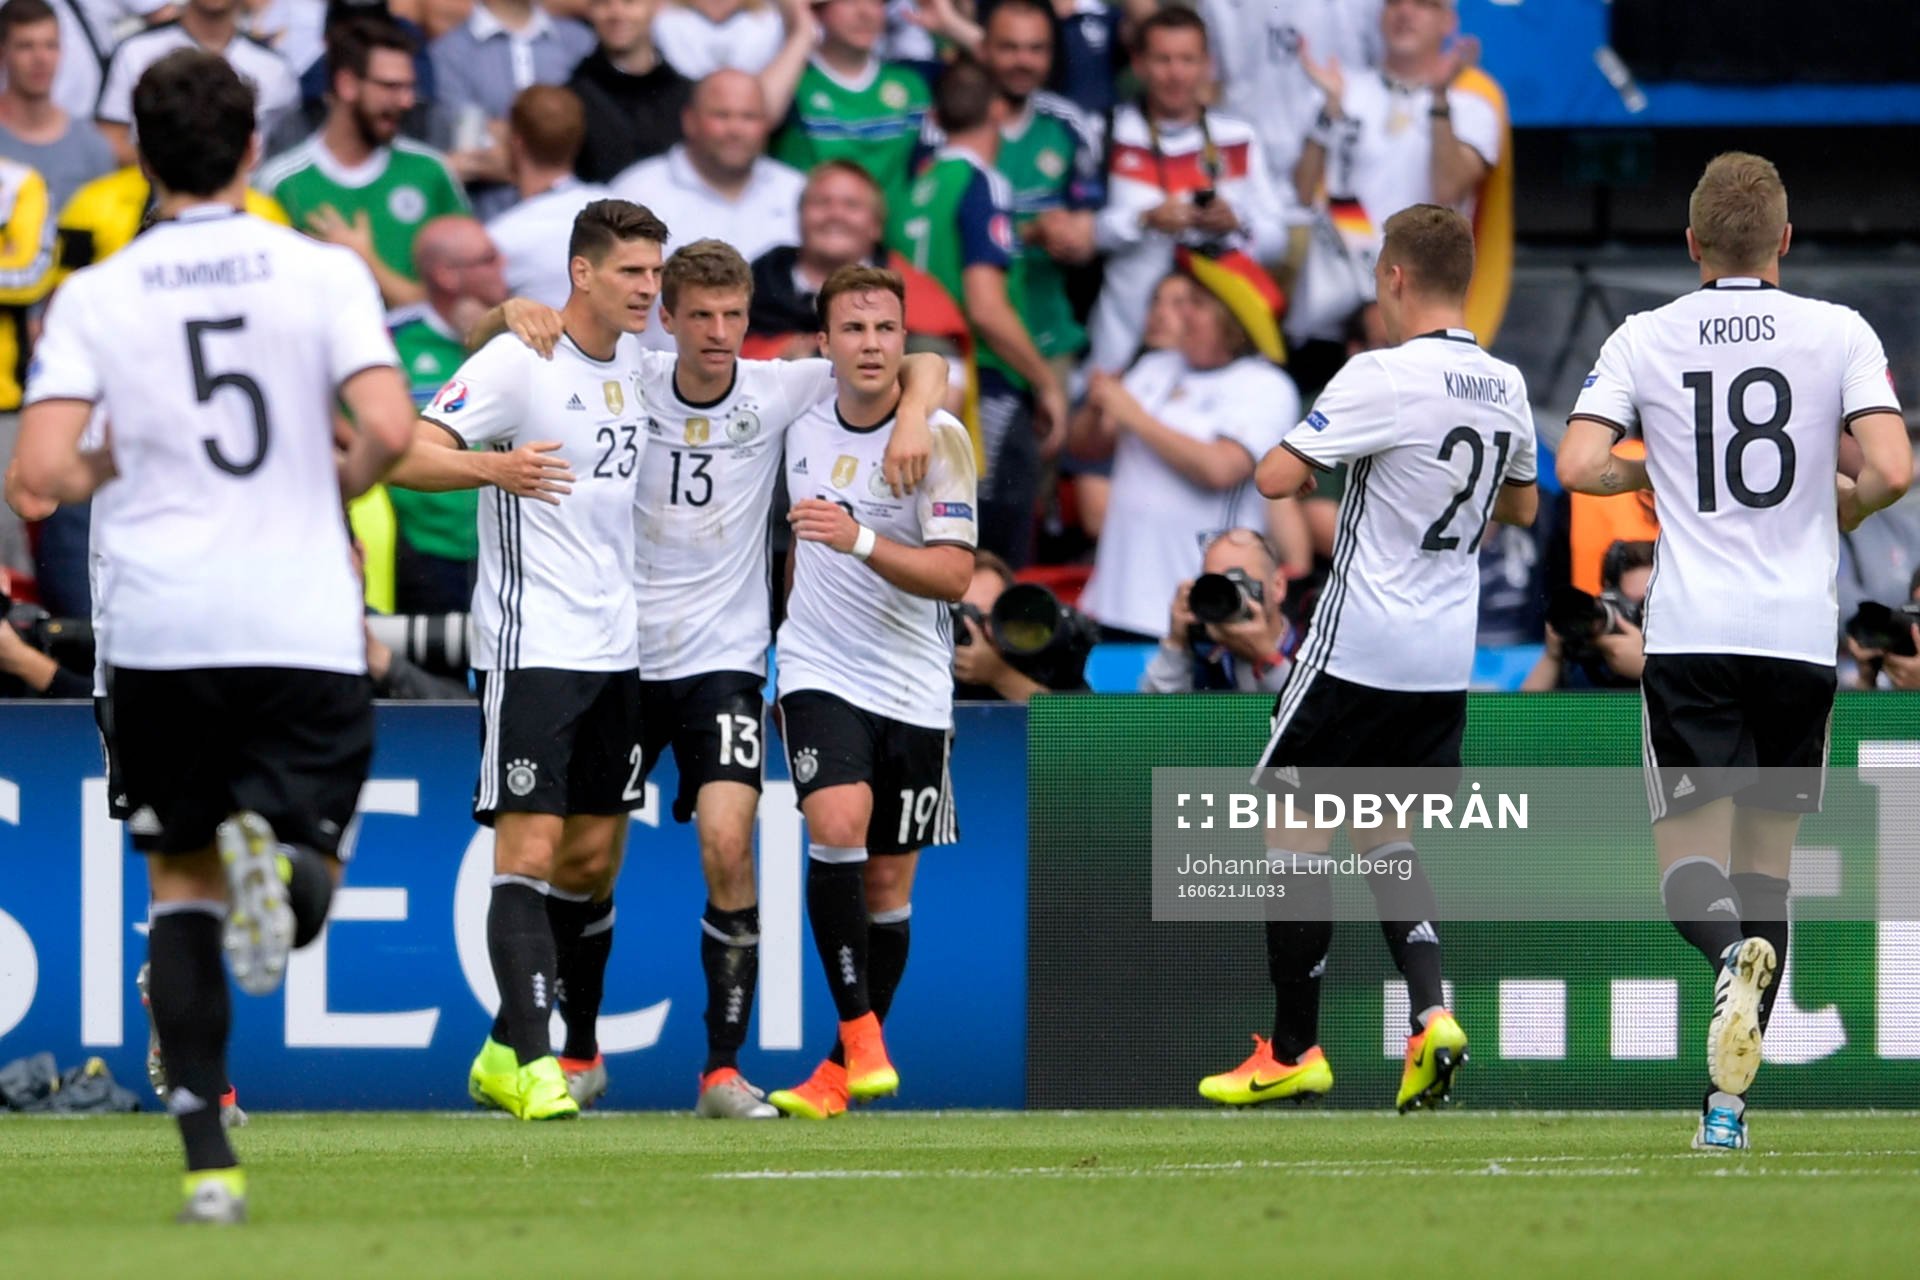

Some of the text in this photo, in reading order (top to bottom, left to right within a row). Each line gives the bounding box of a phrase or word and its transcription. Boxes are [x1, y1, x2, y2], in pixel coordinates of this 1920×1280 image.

[1699, 314, 1776, 345] KROOS
[185, 315, 269, 477] 5
[1443, 371, 1509, 405] KIMMICH
[593, 426, 638, 478] 23
[1682, 366, 1796, 513] 18
[670, 451, 713, 507] 13
[1420, 426, 1512, 554] 21
[716, 713, 760, 769] 13
[898, 786, 938, 844] 19
